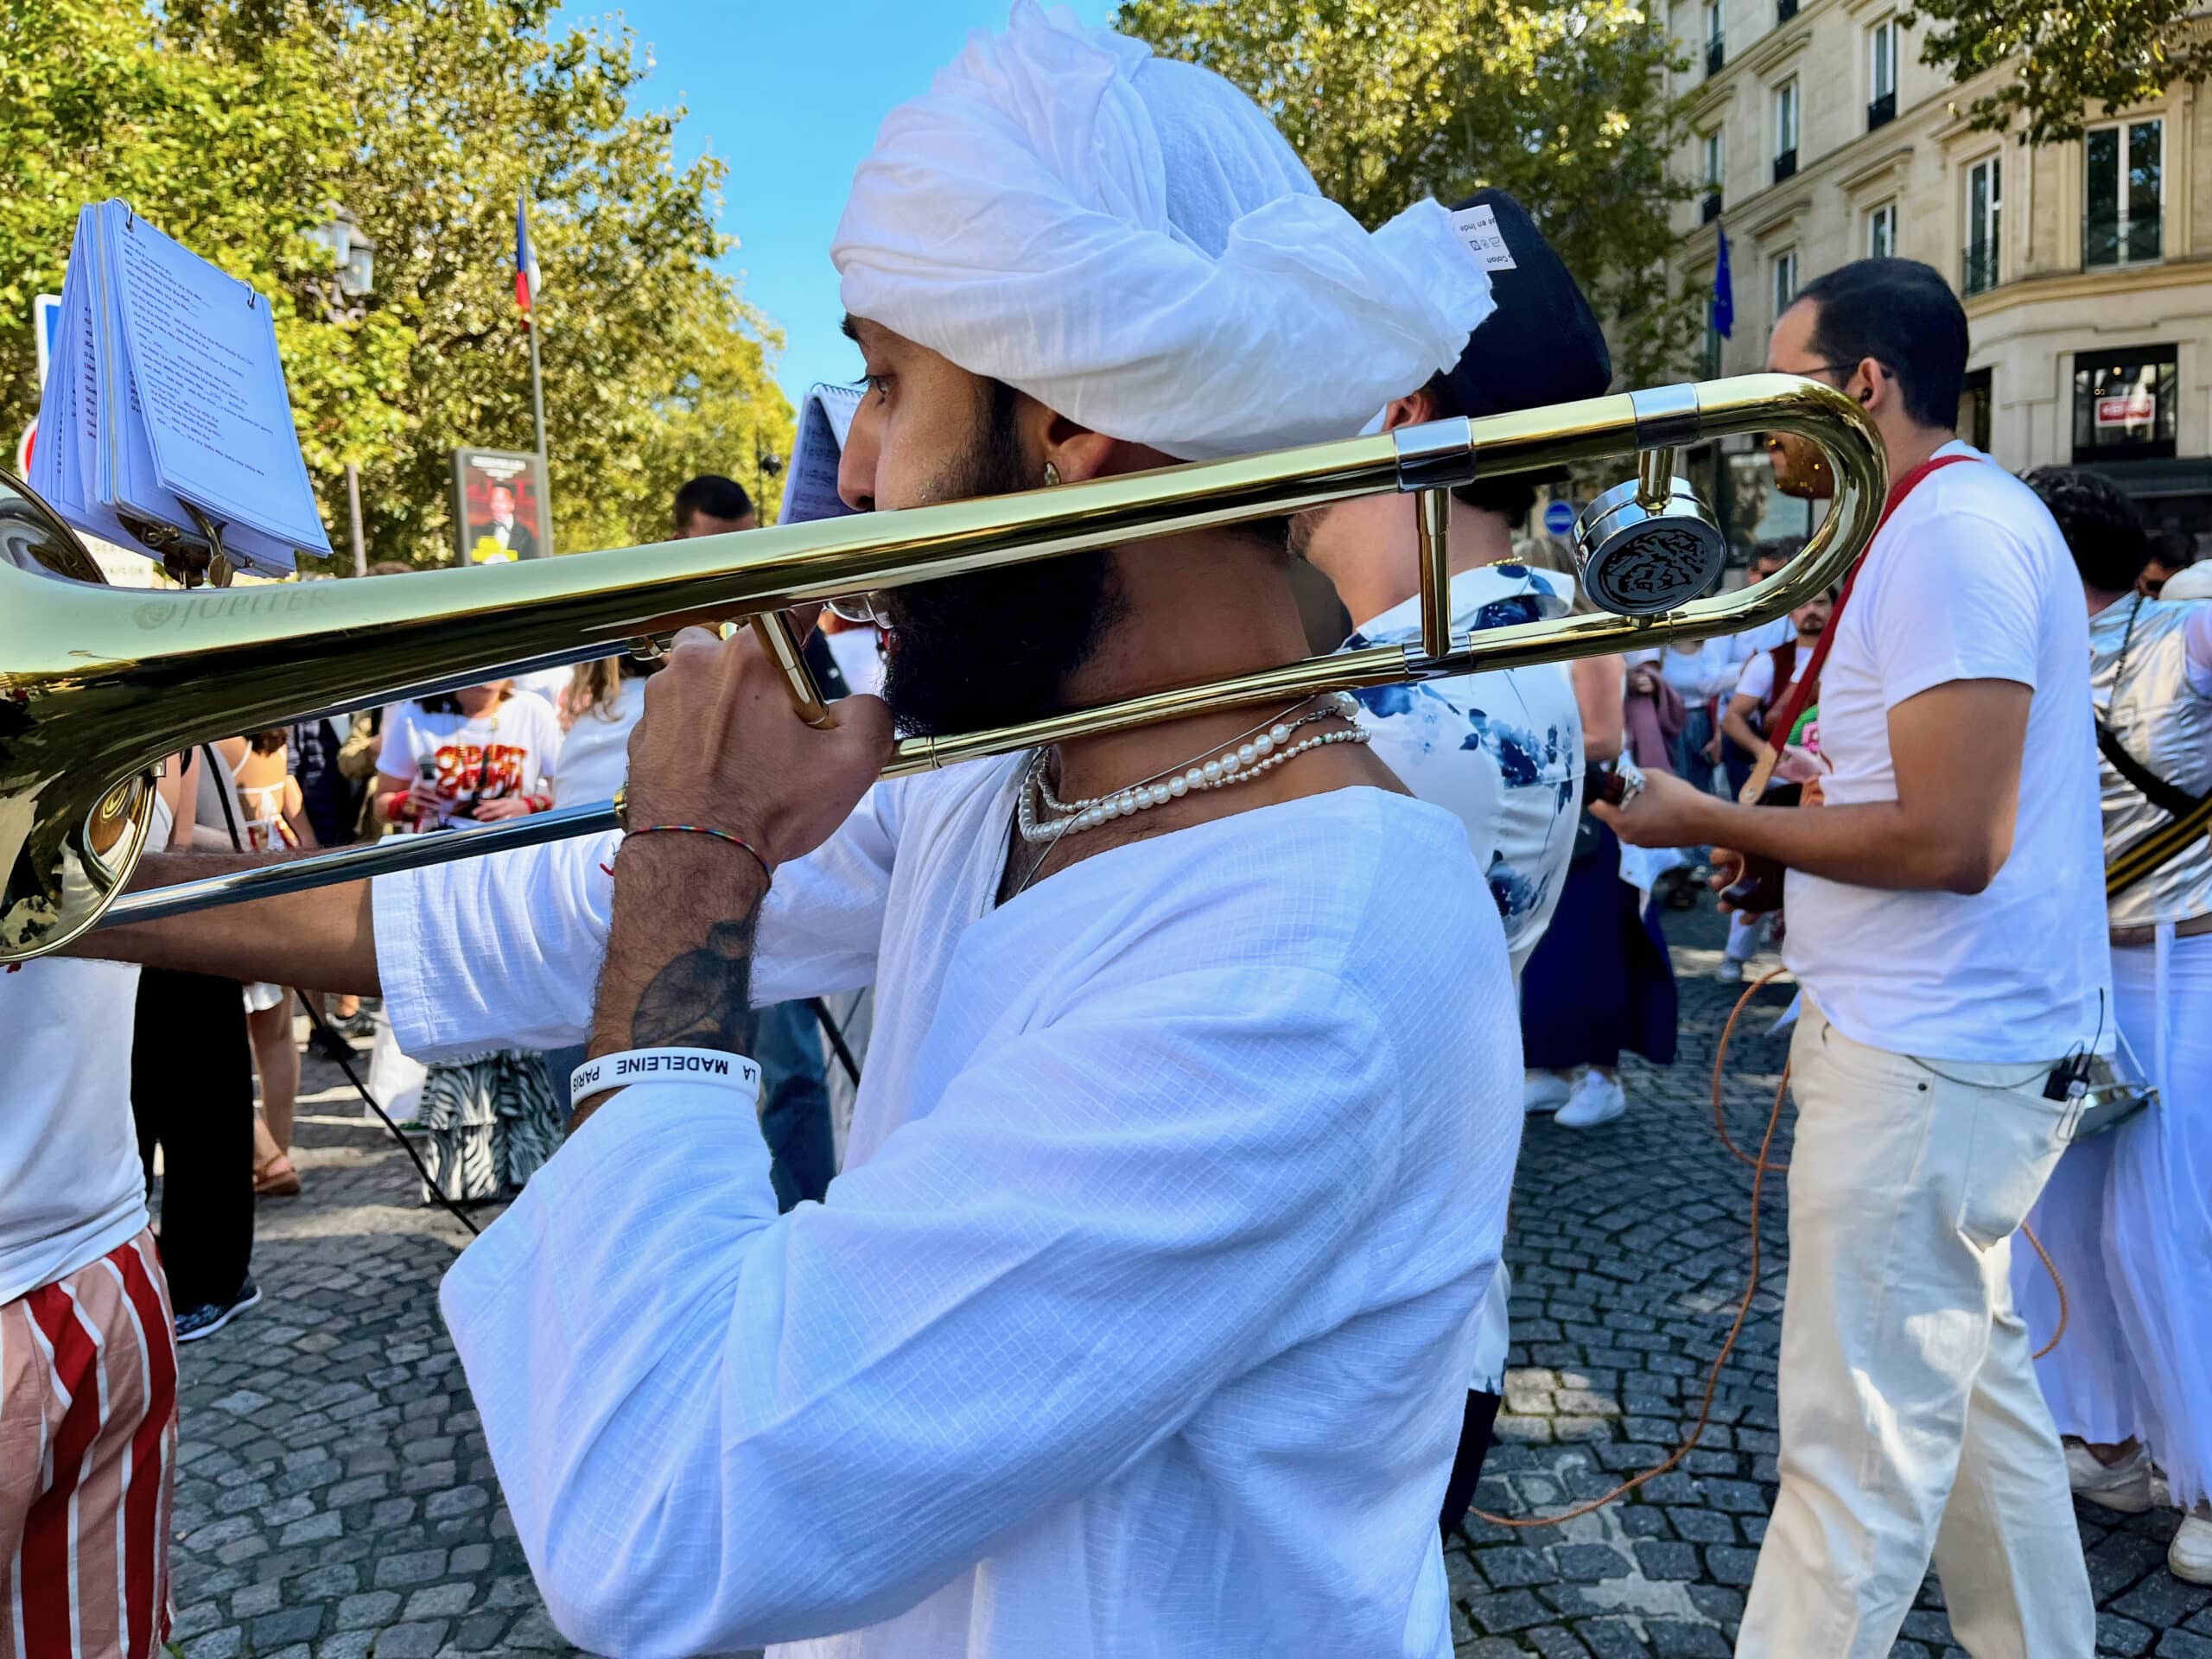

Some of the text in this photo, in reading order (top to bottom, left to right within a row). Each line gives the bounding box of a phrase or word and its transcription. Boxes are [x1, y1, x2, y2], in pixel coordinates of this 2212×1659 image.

[179, 588, 329, 630] JUPITER
[573, 1056, 756, 1092] LA MADELEINE PARIS
